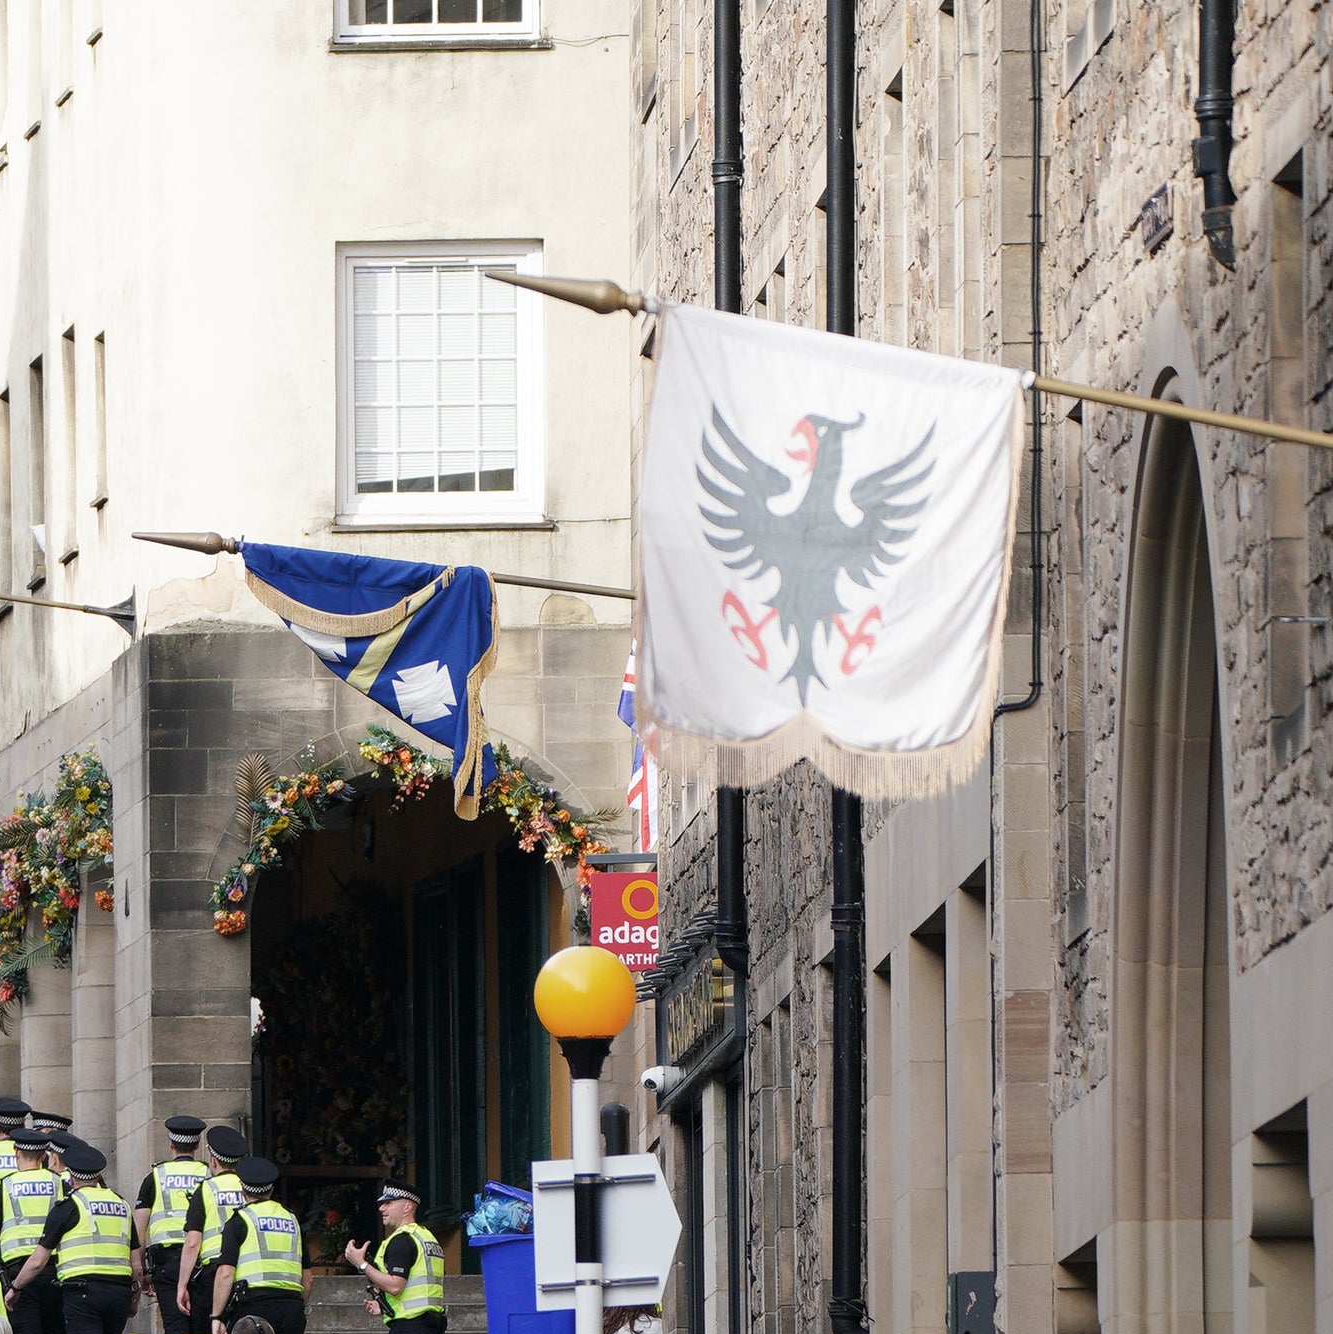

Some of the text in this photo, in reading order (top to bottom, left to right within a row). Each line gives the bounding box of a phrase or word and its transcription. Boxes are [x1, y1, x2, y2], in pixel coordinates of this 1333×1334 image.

[599, 921, 659, 949] adag
[14, 1182, 55, 1195] POLICE
[219, 1192, 242, 1205] POLI
[90, 1202, 127, 1216] POLICE
[259, 1218, 295, 1233] POLICE
